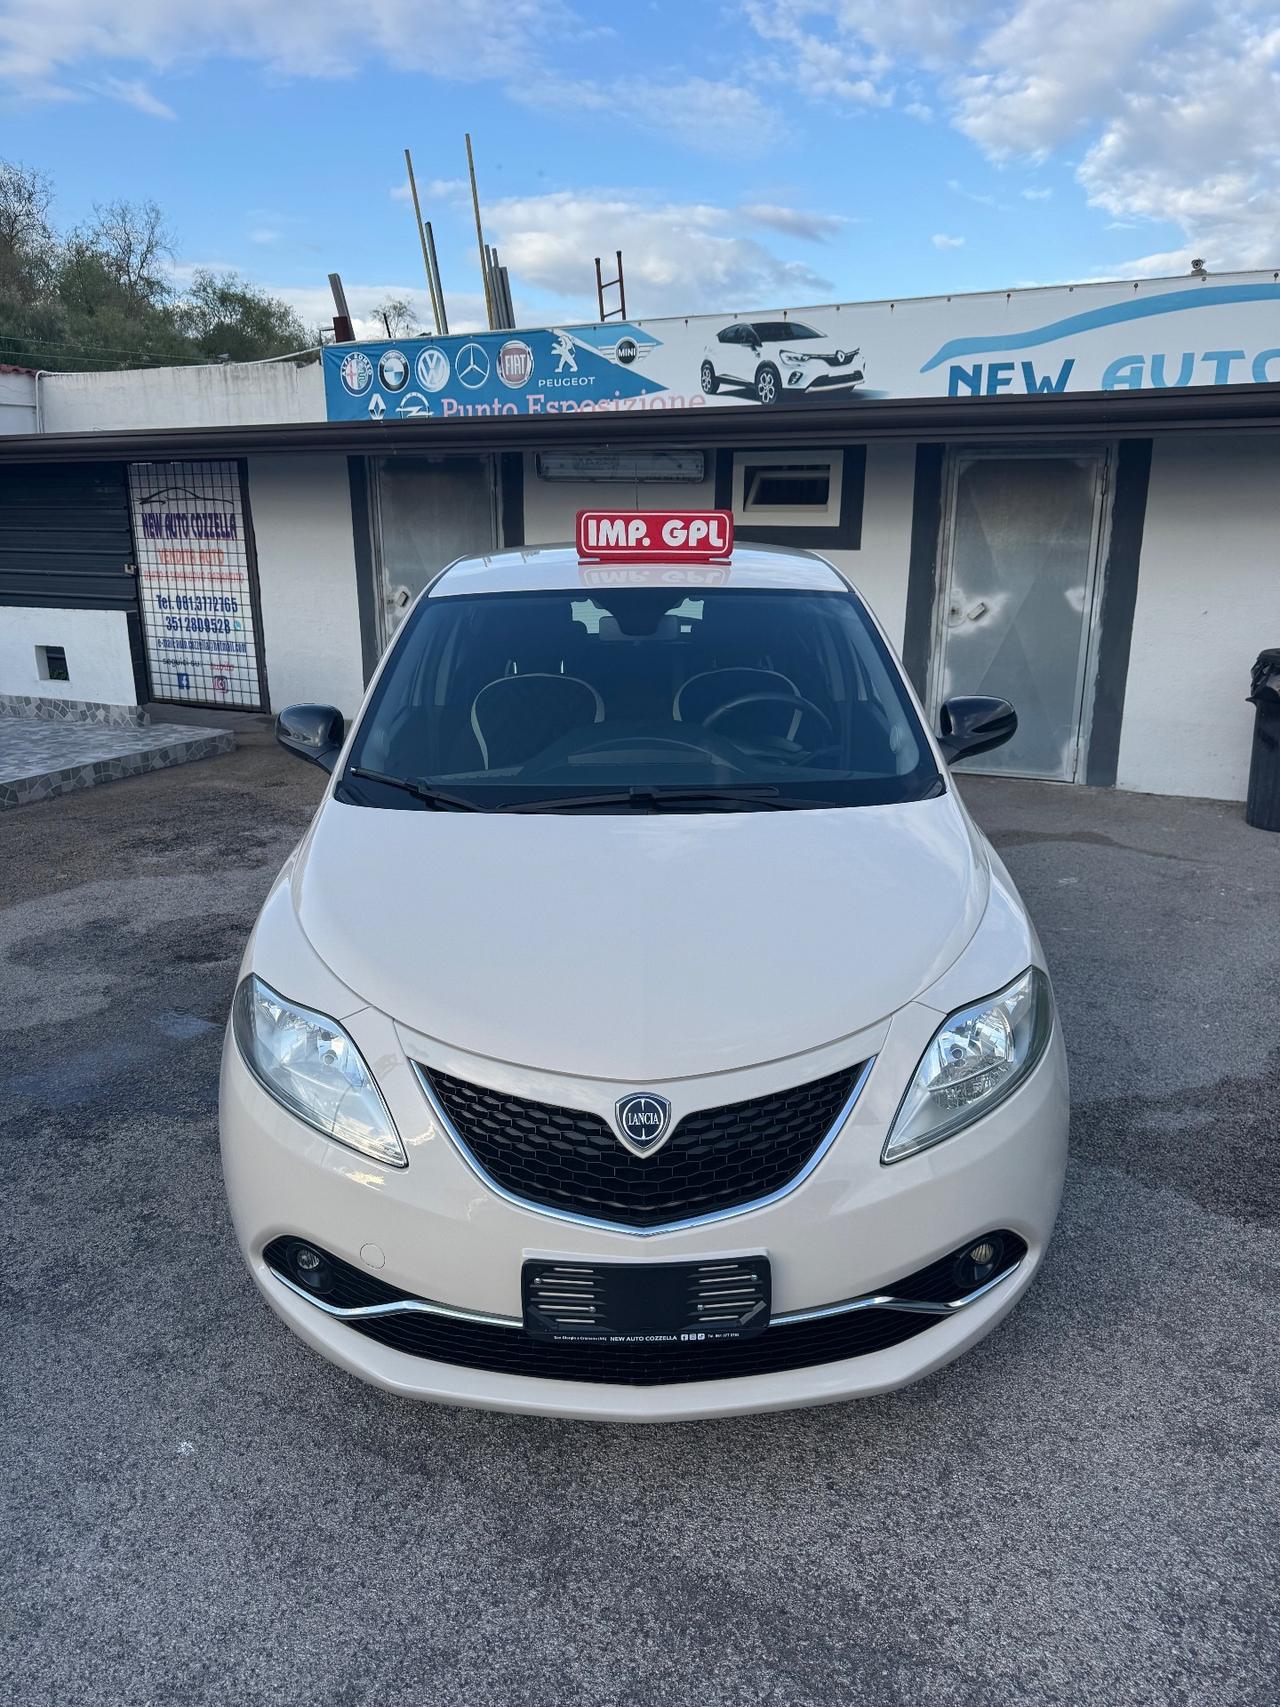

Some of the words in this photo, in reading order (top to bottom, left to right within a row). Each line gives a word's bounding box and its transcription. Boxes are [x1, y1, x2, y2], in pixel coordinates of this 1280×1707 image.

[618, 348, 636, 357] MINI
[505, 354, 526, 375] FIAT
[538, 376, 596, 388] PEUGEOT
[948, 358, 1076, 397] NEW
[441, 398, 518, 418] Punto
[142, 512, 163, 539] NEW
[165, 512, 189, 540] AUTO
[191, 512, 238, 541] COZZELLA
[587, 519, 651, 547] IMP.
[661, 519, 724, 547] GPL
[156, 594, 174, 610] Tel.
[628, 1112, 659, 1126] LANCIA
